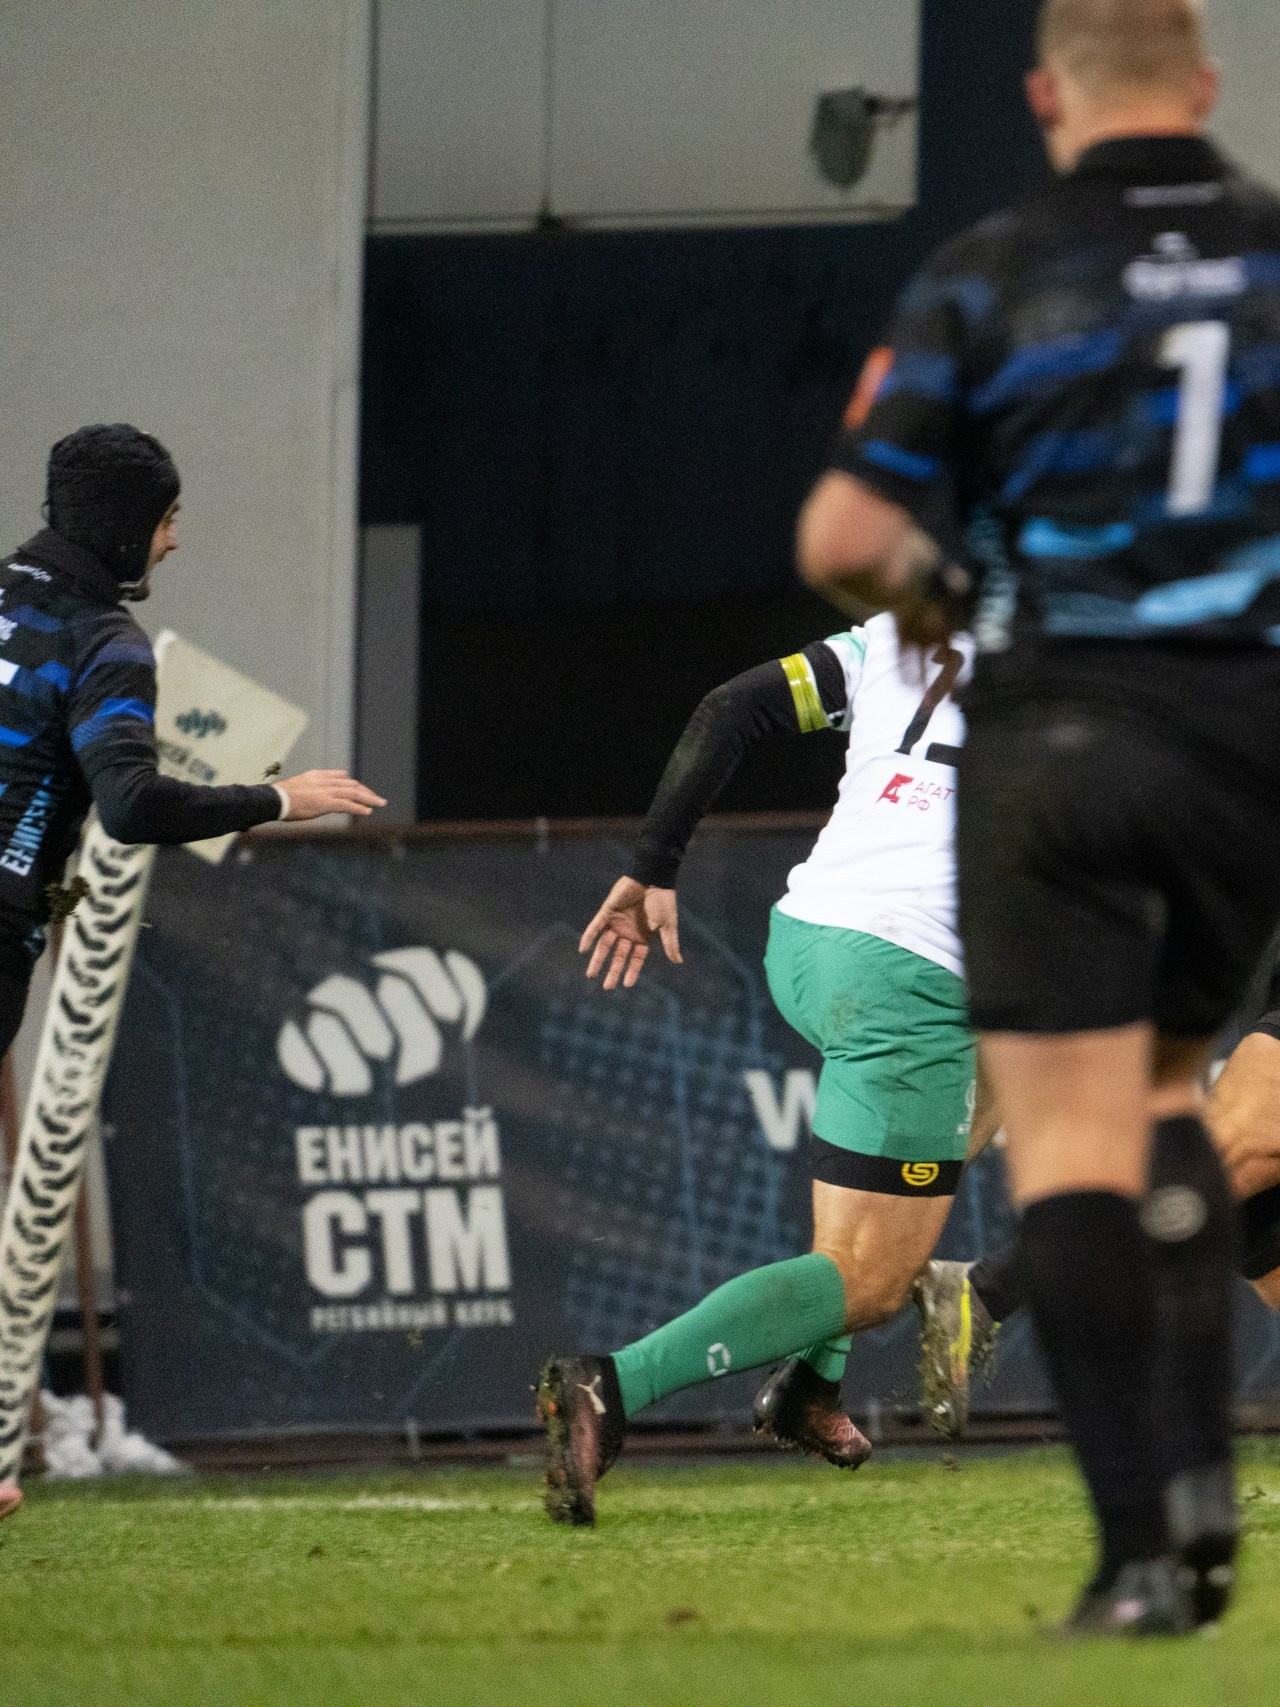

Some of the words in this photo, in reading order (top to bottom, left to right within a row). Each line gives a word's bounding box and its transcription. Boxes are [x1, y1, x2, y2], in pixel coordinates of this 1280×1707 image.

[1157, 318, 1232, 517] 1
[296, 1106, 502, 1184] ЕНИСЕЙ
[303, 1186, 512, 1298] СТМ
